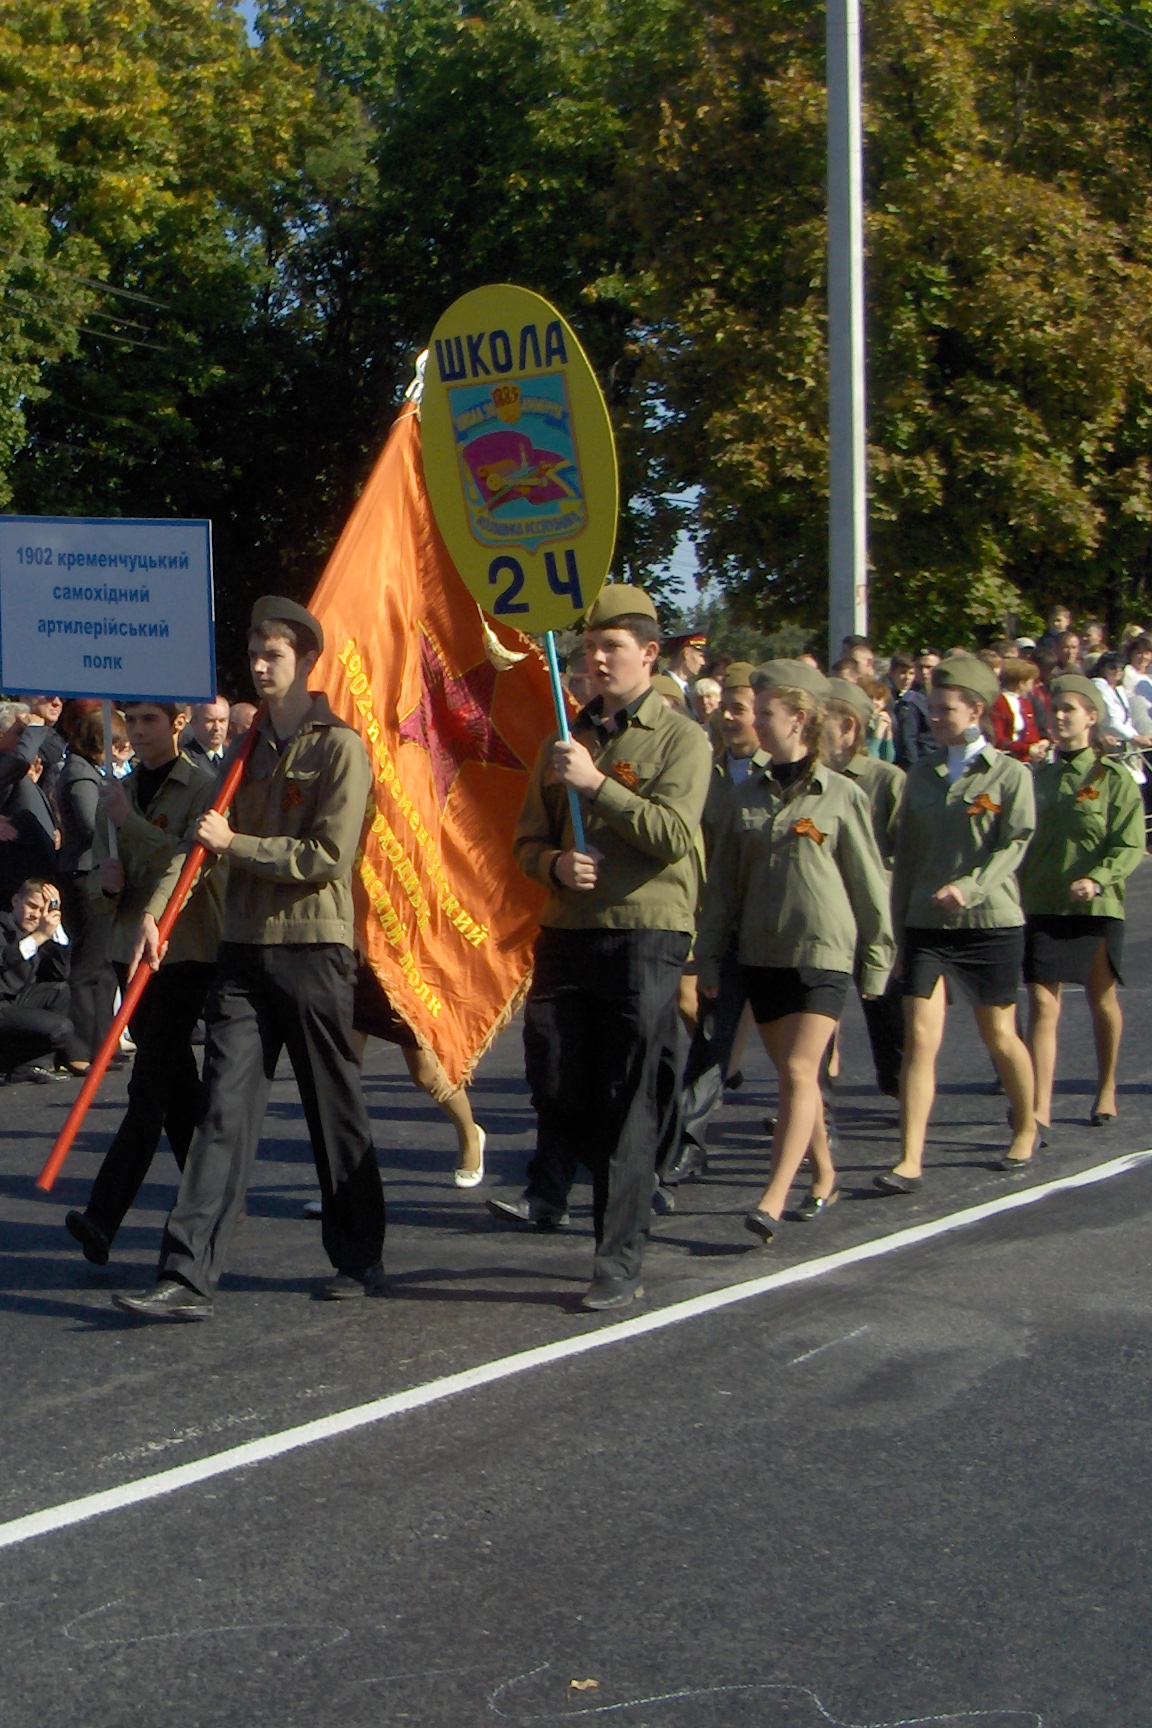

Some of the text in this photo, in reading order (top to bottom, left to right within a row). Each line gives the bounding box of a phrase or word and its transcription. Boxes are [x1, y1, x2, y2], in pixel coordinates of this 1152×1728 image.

[435, 321, 567, 382] ШКОЛА
[16, 546, 189, 573] 1902 кременчуцький
[52, 583, 150, 605] самохідний
[37, 617, 170, 640] артилерійський
[82, 655, 123, 669] полк
